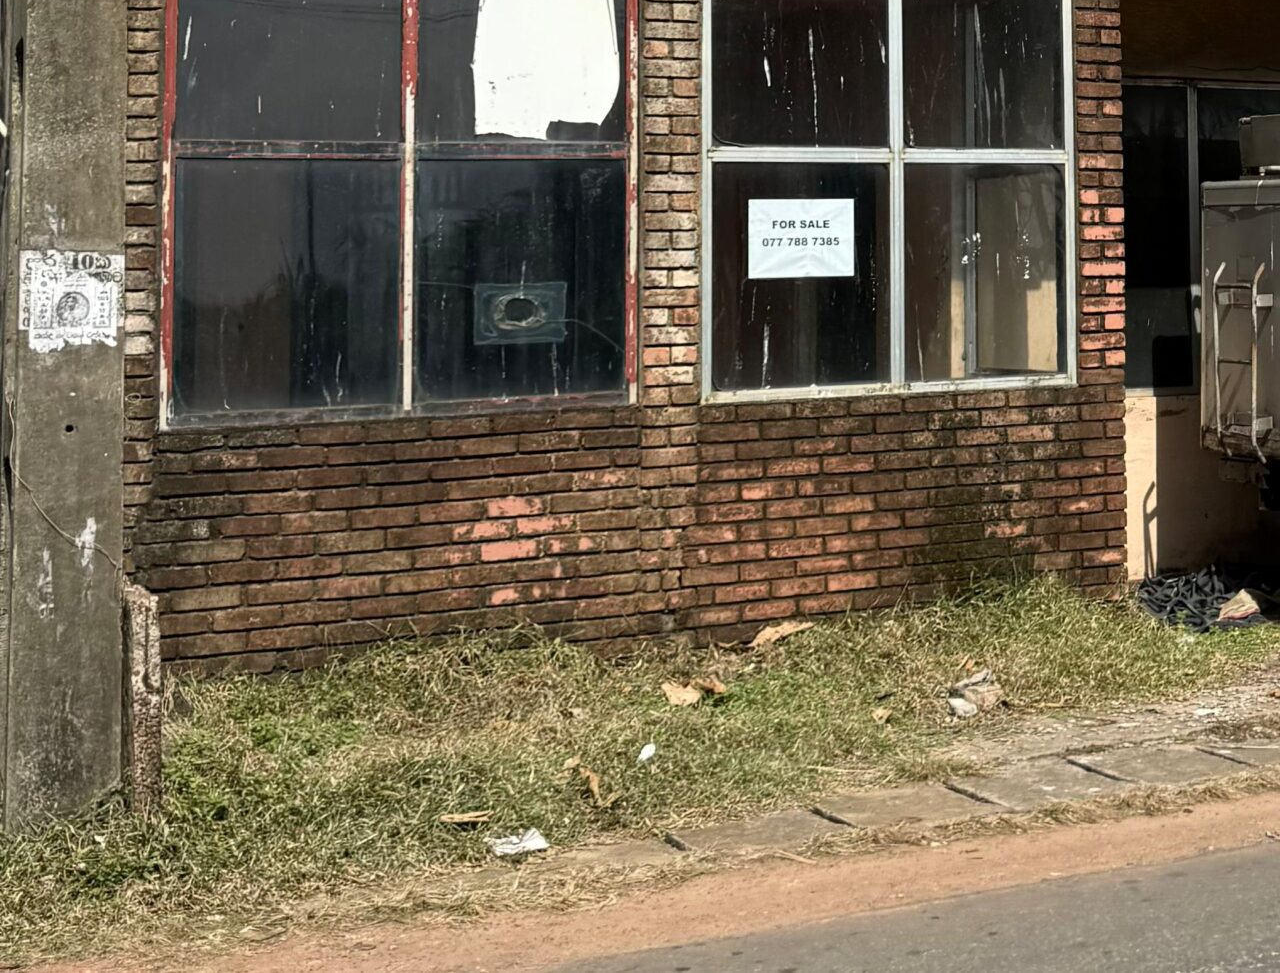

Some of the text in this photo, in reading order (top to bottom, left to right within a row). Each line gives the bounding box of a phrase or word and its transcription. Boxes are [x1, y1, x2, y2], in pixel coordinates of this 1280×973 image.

[772, 220, 830, 229] FOR SALE
[762, 236, 840, 247] 077 788 7385
